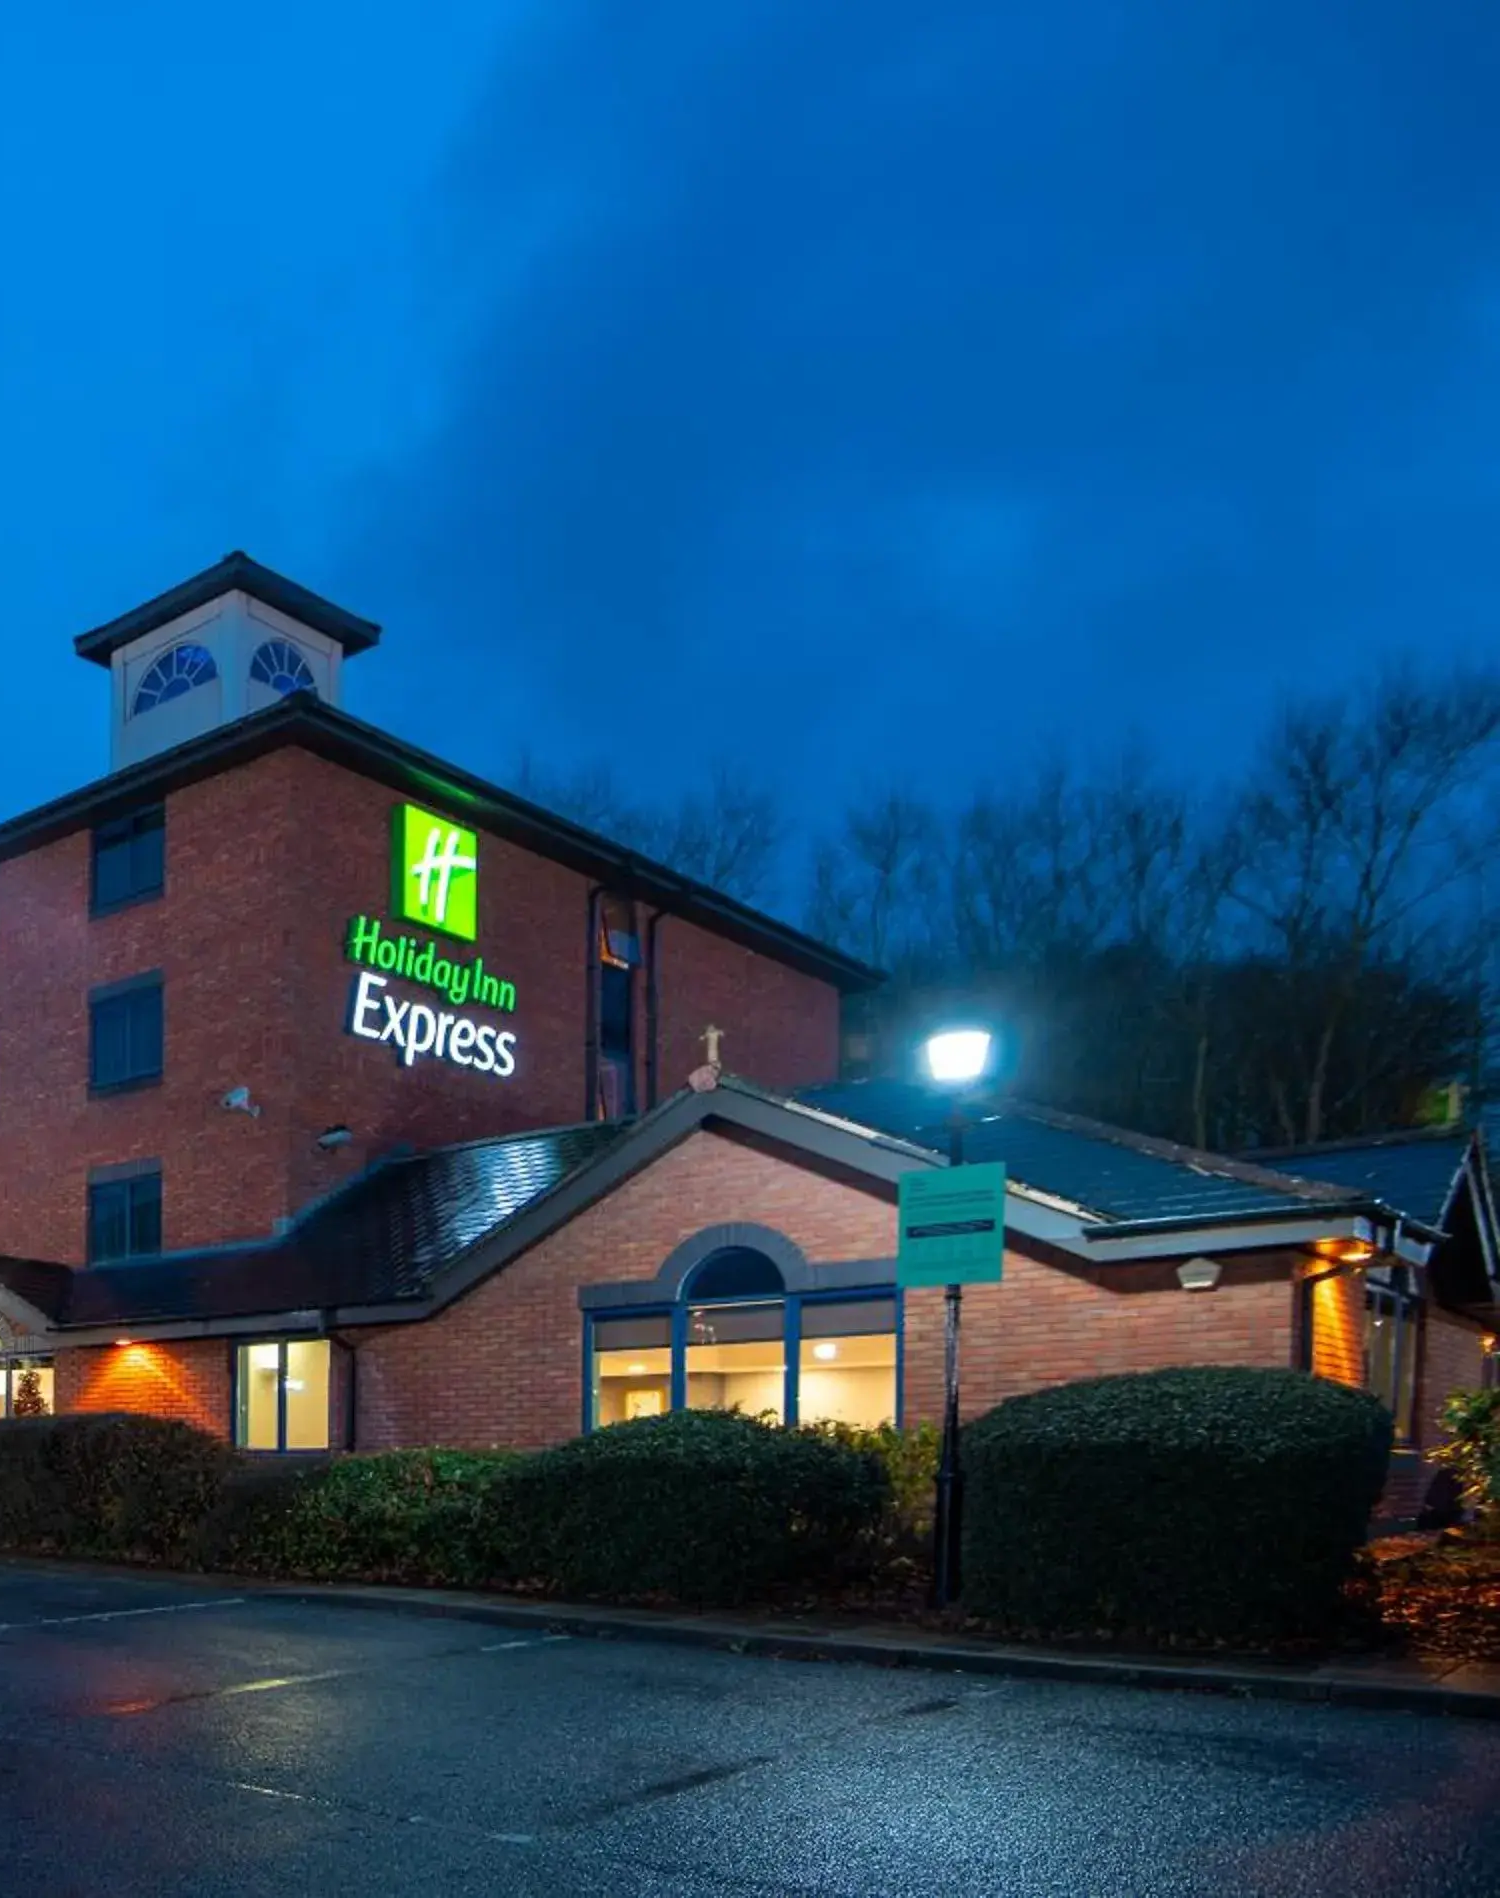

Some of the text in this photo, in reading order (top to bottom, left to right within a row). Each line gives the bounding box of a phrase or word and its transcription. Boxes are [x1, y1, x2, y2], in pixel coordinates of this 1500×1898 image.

[353, 916, 516, 1011] Holiday Inn
[352, 970, 517, 1077] Express
